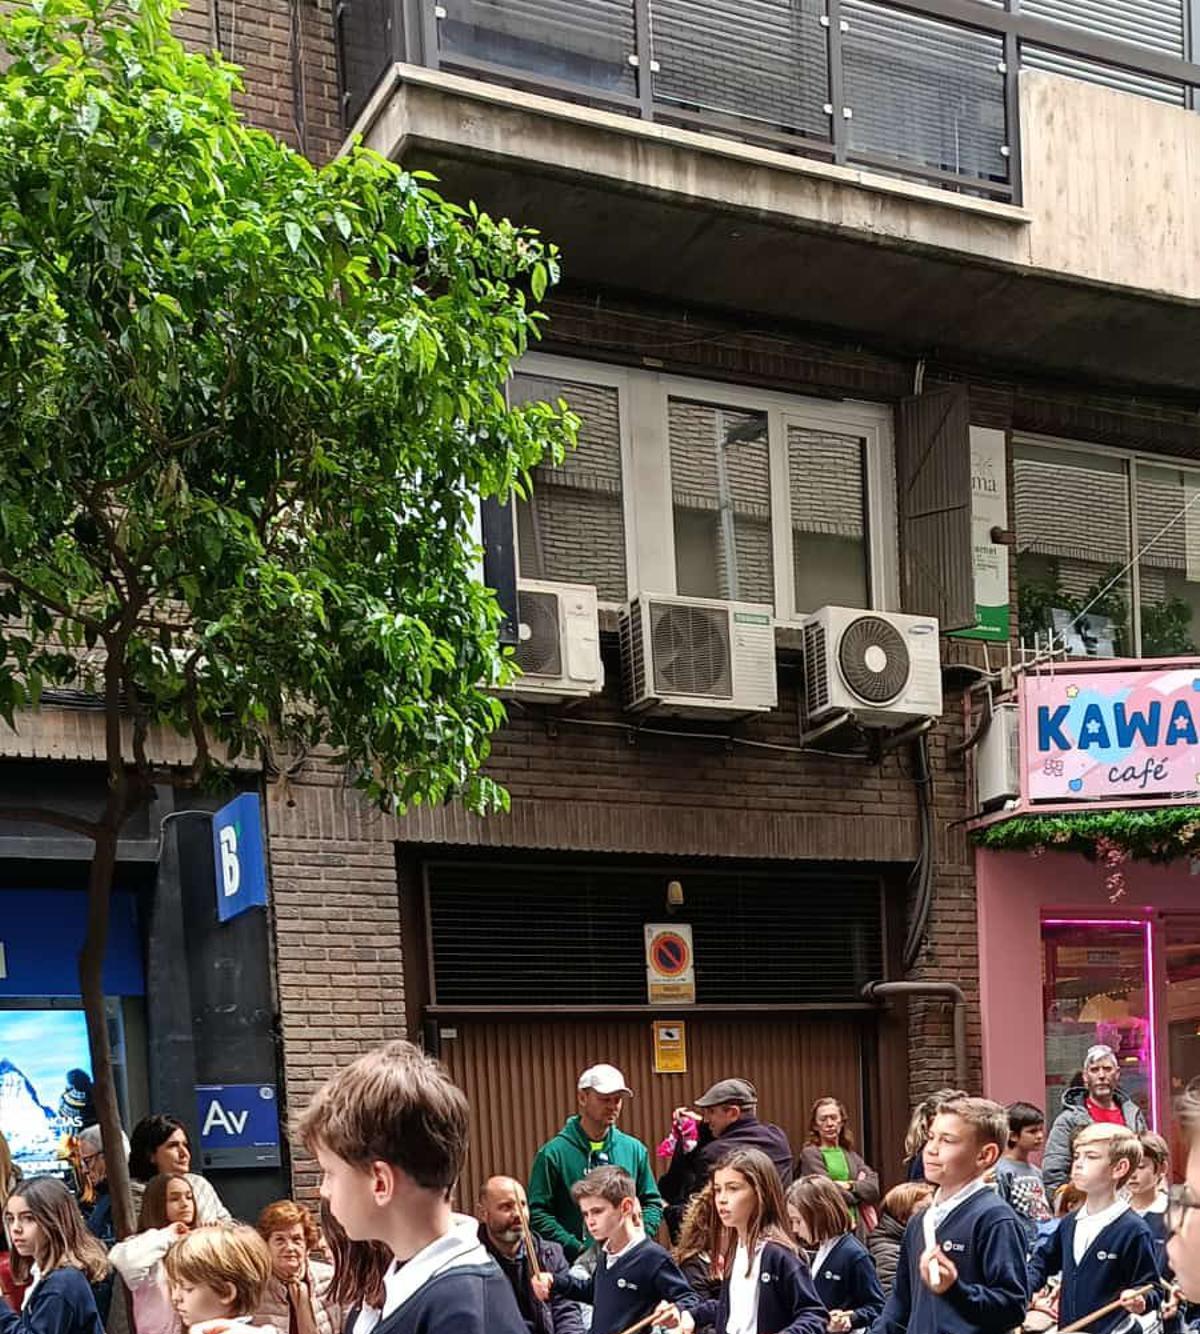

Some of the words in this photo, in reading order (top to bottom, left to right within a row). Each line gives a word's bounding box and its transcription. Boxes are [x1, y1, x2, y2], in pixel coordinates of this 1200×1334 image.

[1037, 700, 1199, 752] KAWA
[1108, 757, 1169, 789] café
[202, 1099, 249, 1137] Av
